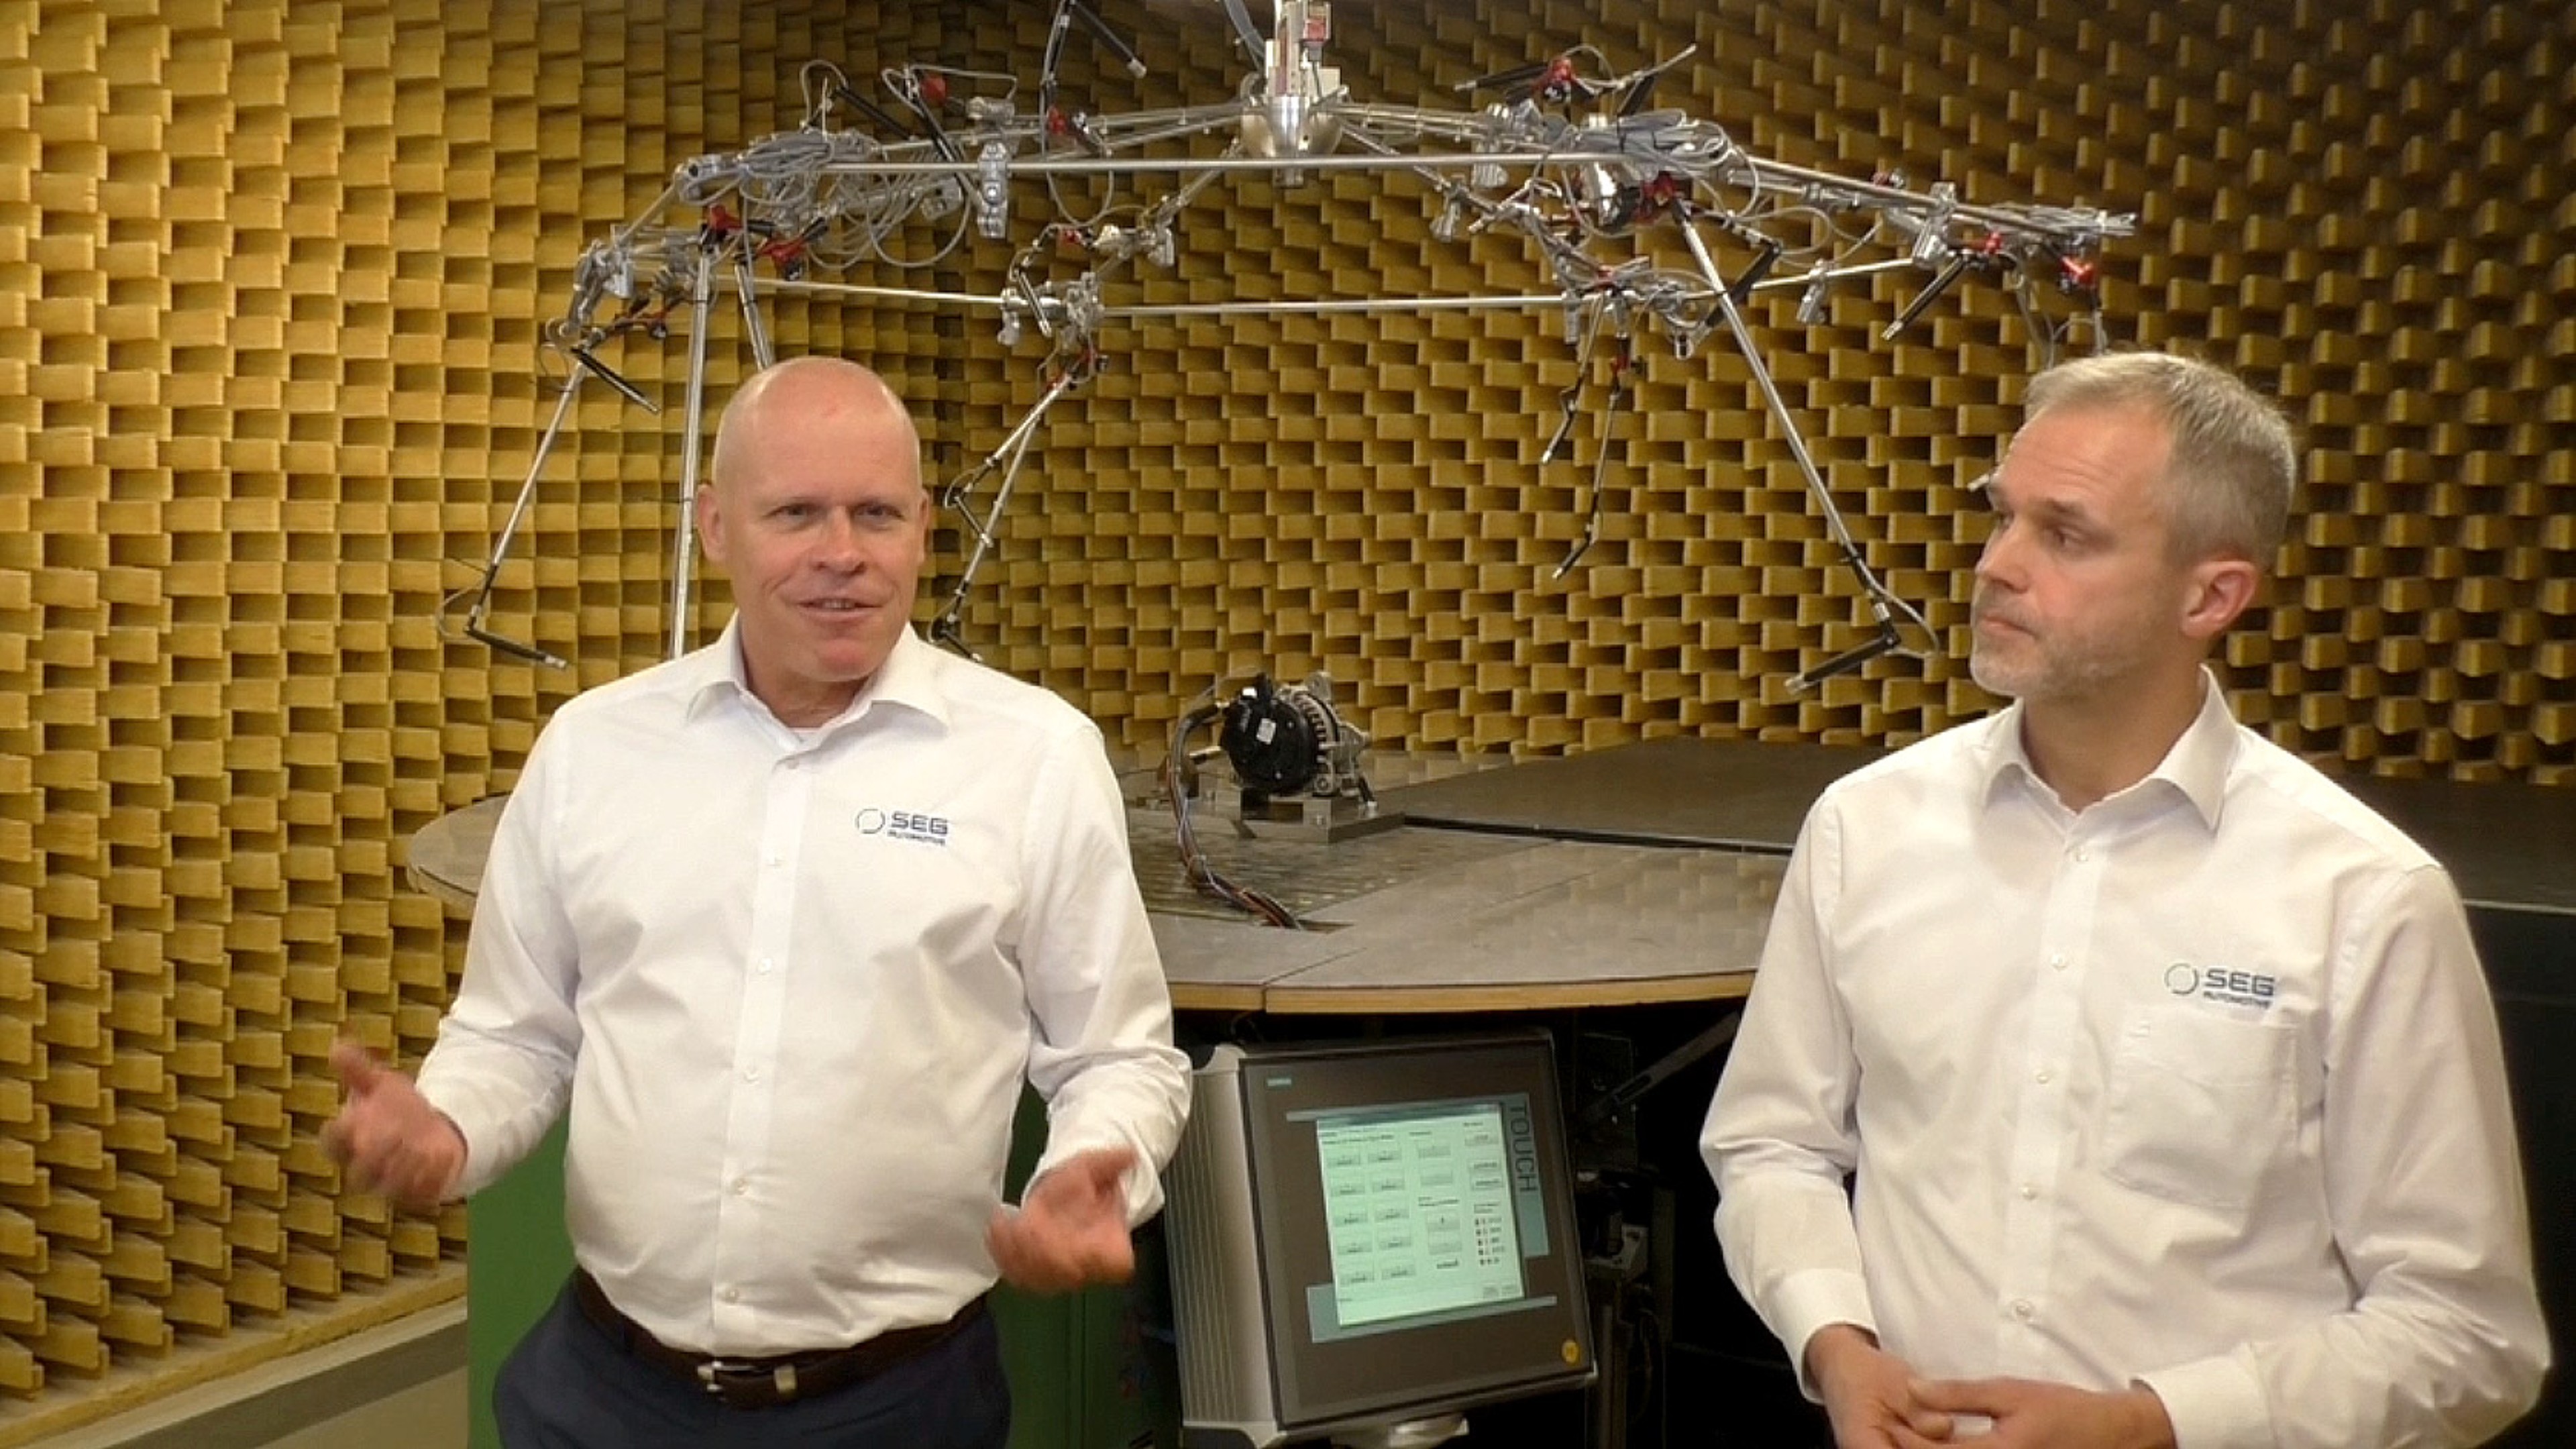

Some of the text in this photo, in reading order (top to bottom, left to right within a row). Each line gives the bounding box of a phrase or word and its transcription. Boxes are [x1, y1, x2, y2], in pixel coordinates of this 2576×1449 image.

[891, 811, 948, 835] SEG
[2204, 969, 2275, 996] SEG
[1510, 1101, 1538, 1191] TOUCH
